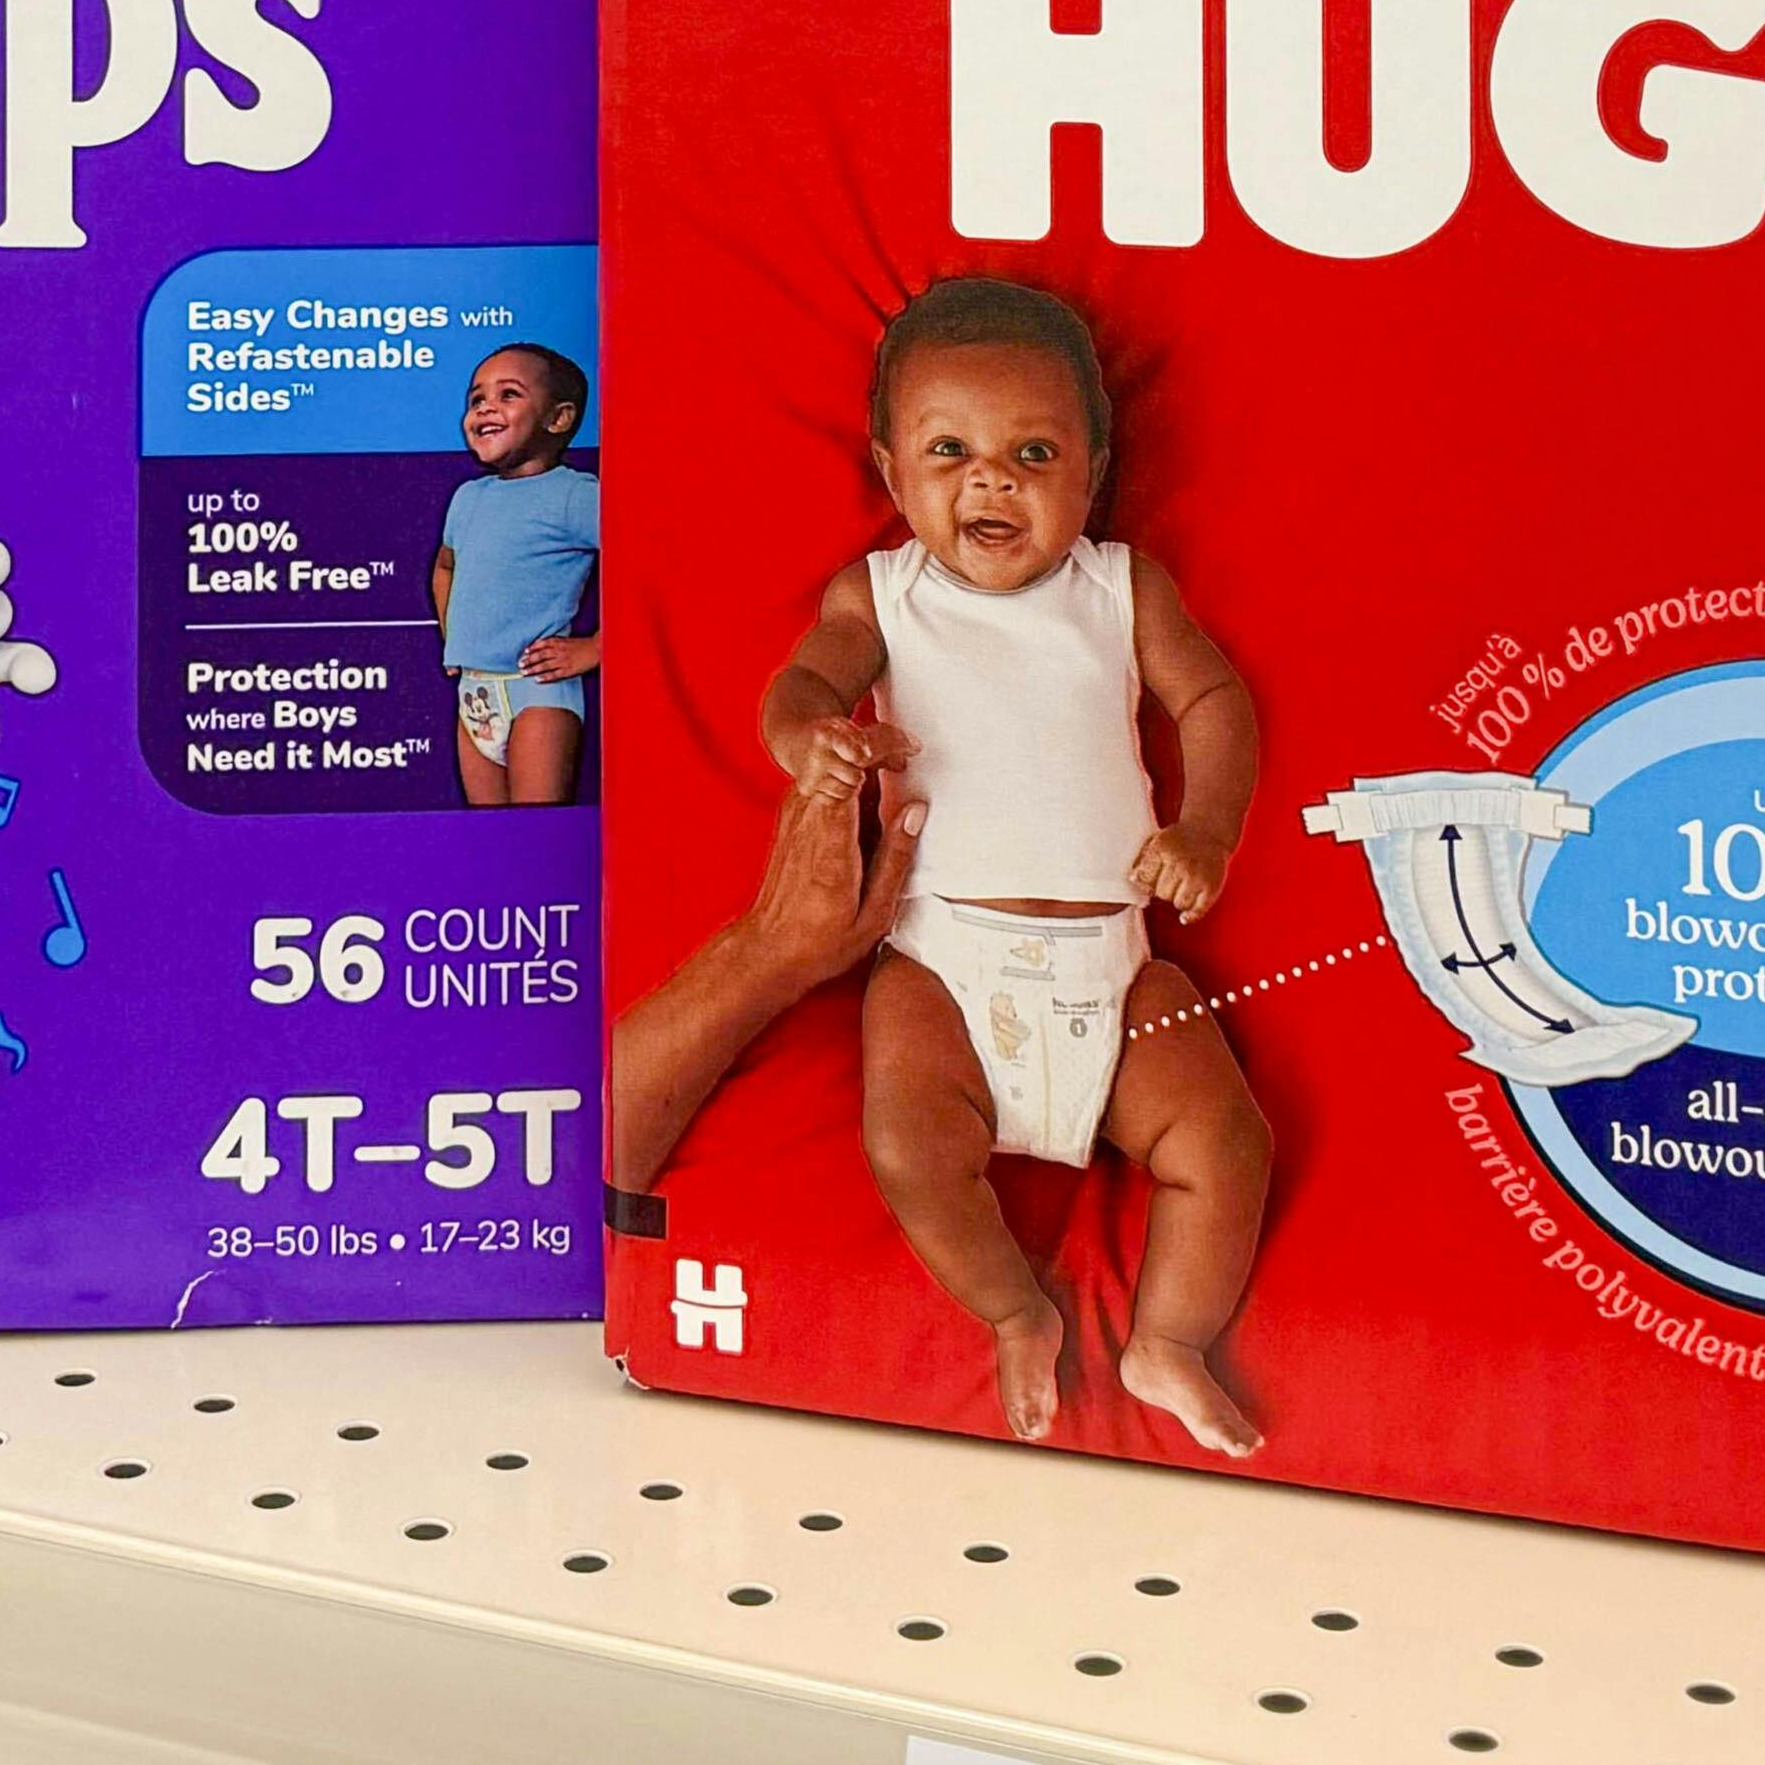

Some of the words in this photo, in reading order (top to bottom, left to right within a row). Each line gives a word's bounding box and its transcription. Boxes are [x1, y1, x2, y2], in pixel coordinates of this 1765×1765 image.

[189, 302, 274, 336] Easy
[287, 300, 448, 334] Changes
[461, 306, 512, 326] with
[189, 340, 434, 371] Refastenable
[188, 494, 223, 518] up
[231, 490, 259, 511] to
[189, 521, 297, 552] 100%
[189, 562, 277, 592] Leak
[188, 659, 386, 692] Protection
[1466, 686, 1530, 764] 100
[1565, 626, 1615, 672] de
[186, 708, 265, 730] where
[274, 701, 356, 733] Boys
[188, 742, 274, 771] Need
[287, 741, 312, 769] it
[405, 905, 580, 953] COUNT
[251, 916, 384, 1003] 56
[405, 949, 579, 1008] UNITÉS
[1444, 1085, 1557, 1243] barrière
[332, 1225, 377, 1255] lbs
[533, 1219, 569, 1254] kg
